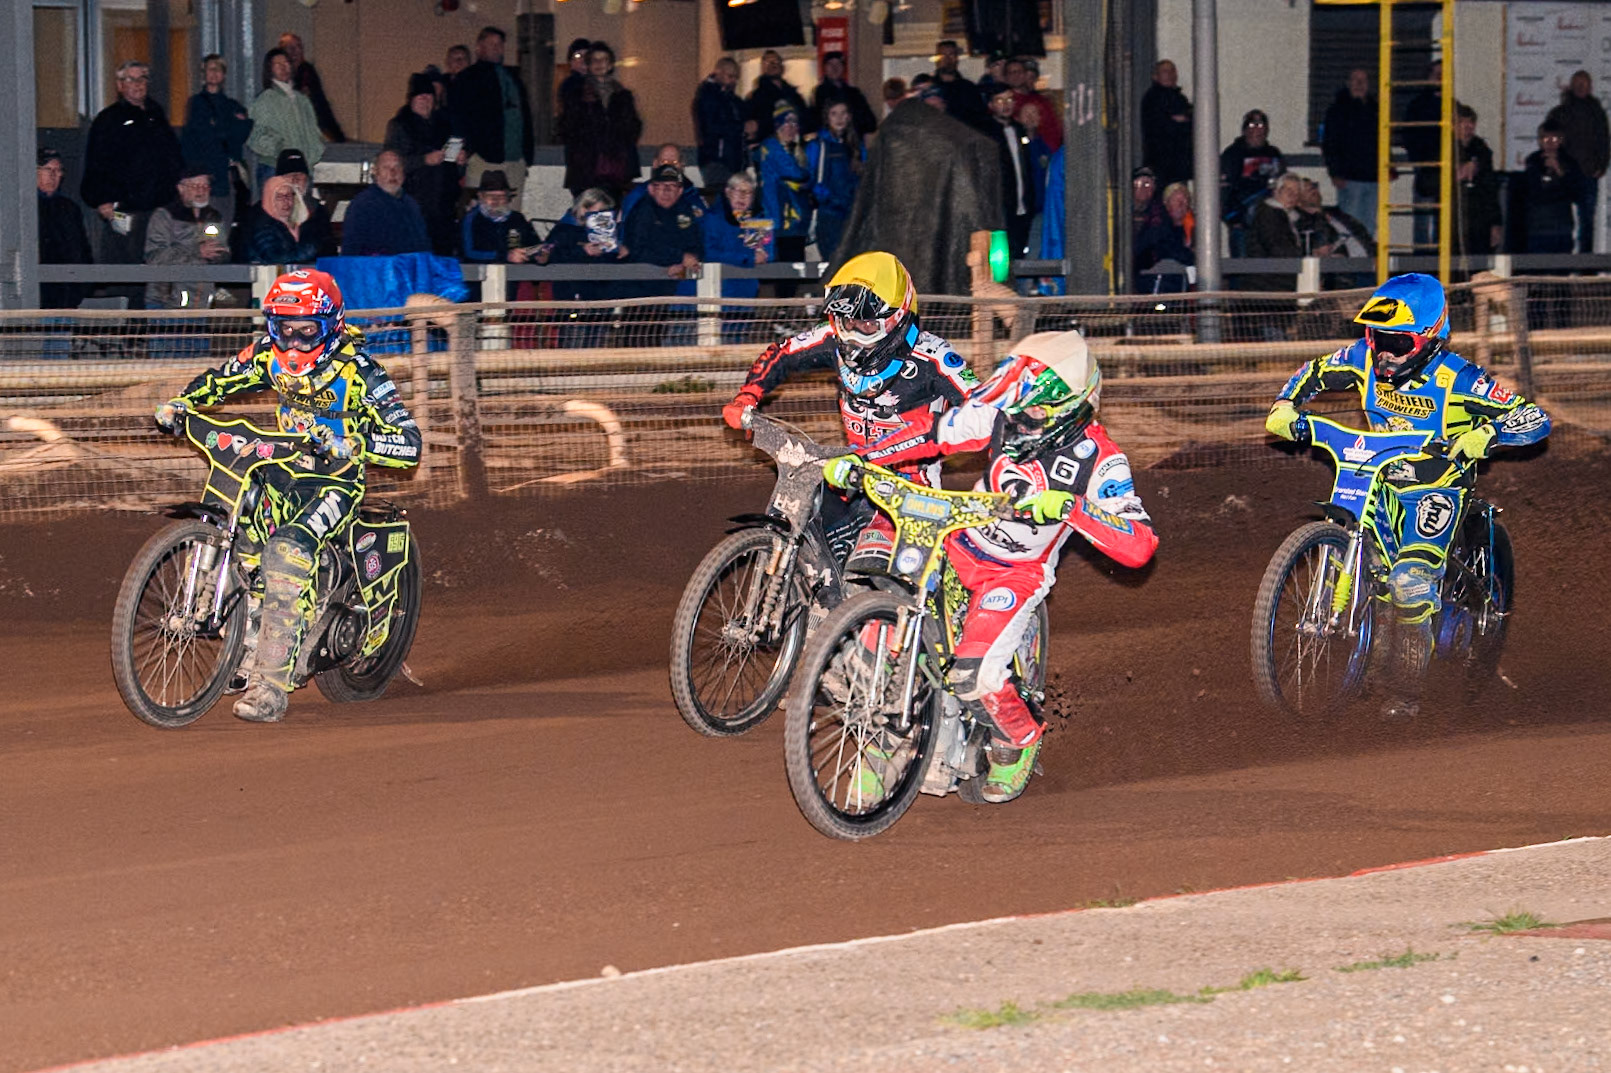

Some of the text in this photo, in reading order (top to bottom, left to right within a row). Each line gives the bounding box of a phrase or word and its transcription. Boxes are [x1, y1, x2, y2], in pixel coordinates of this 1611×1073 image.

[1436, 373, 1450, 388] 6
[1375, 383, 1435, 410] SHEFFIELD
[1376, 397, 1428, 416] PROWLERS
[373, 442, 417, 457] BUTCHER
[1056, 461, 1075, 480] 6
